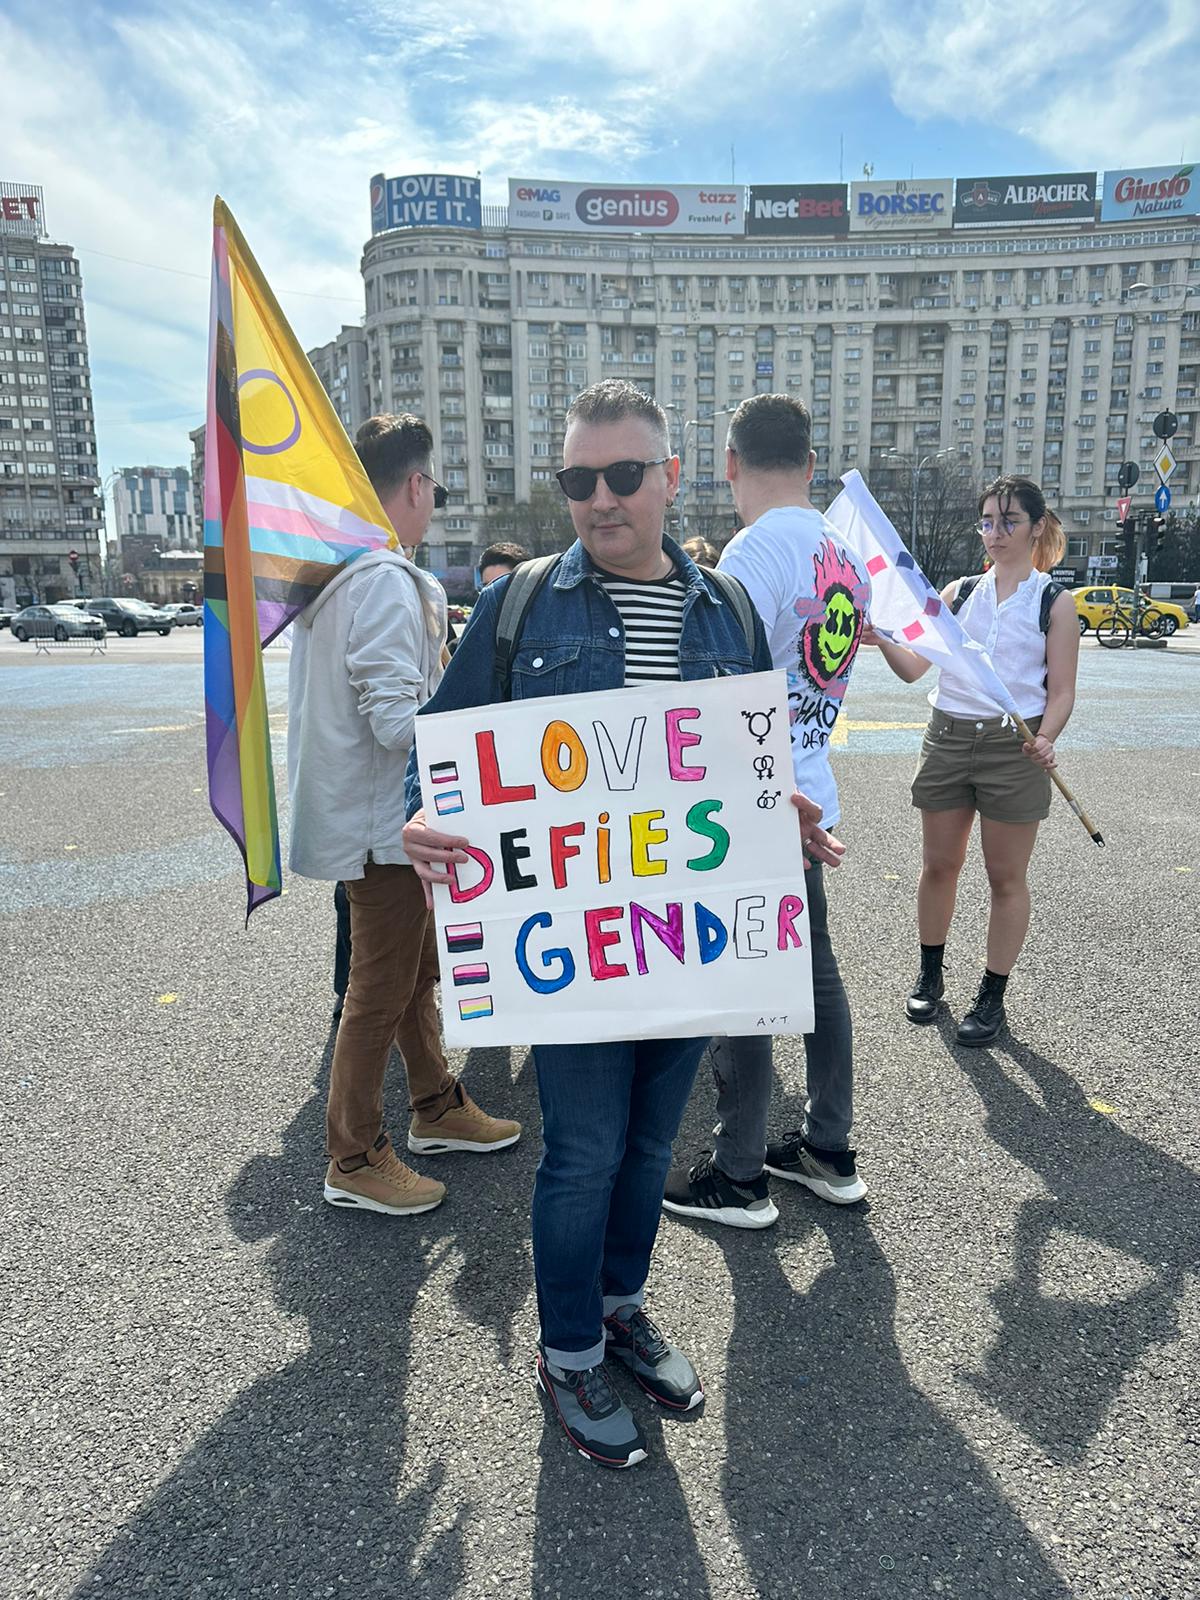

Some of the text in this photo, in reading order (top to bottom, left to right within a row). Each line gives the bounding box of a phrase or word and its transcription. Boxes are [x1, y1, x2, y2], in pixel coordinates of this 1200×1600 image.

[392, 176, 480, 200] LOVE IT.
[516, 187, 561, 203] eMAG
[699, 191, 737, 204] tazz
[1003, 183, 1090, 204] ALBACHER
[1114, 175, 1191, 202] Giusto
[0, 197, 40, 220] ET
[392, 200, 472, 224] LIVE IT.
[586, 193, 669, 220] genius
[754, 197, 844, 219] NetBet
[857, 192, 945, 216] BORSEC
[1132, 199, 1185, 217] Natura
[688, 214, 722, 223] Freshful
[788, 692, 843, 729] CHAO
[475, 707, 707, 806] LOVE
[515, 895, 804, 995] GENDER
